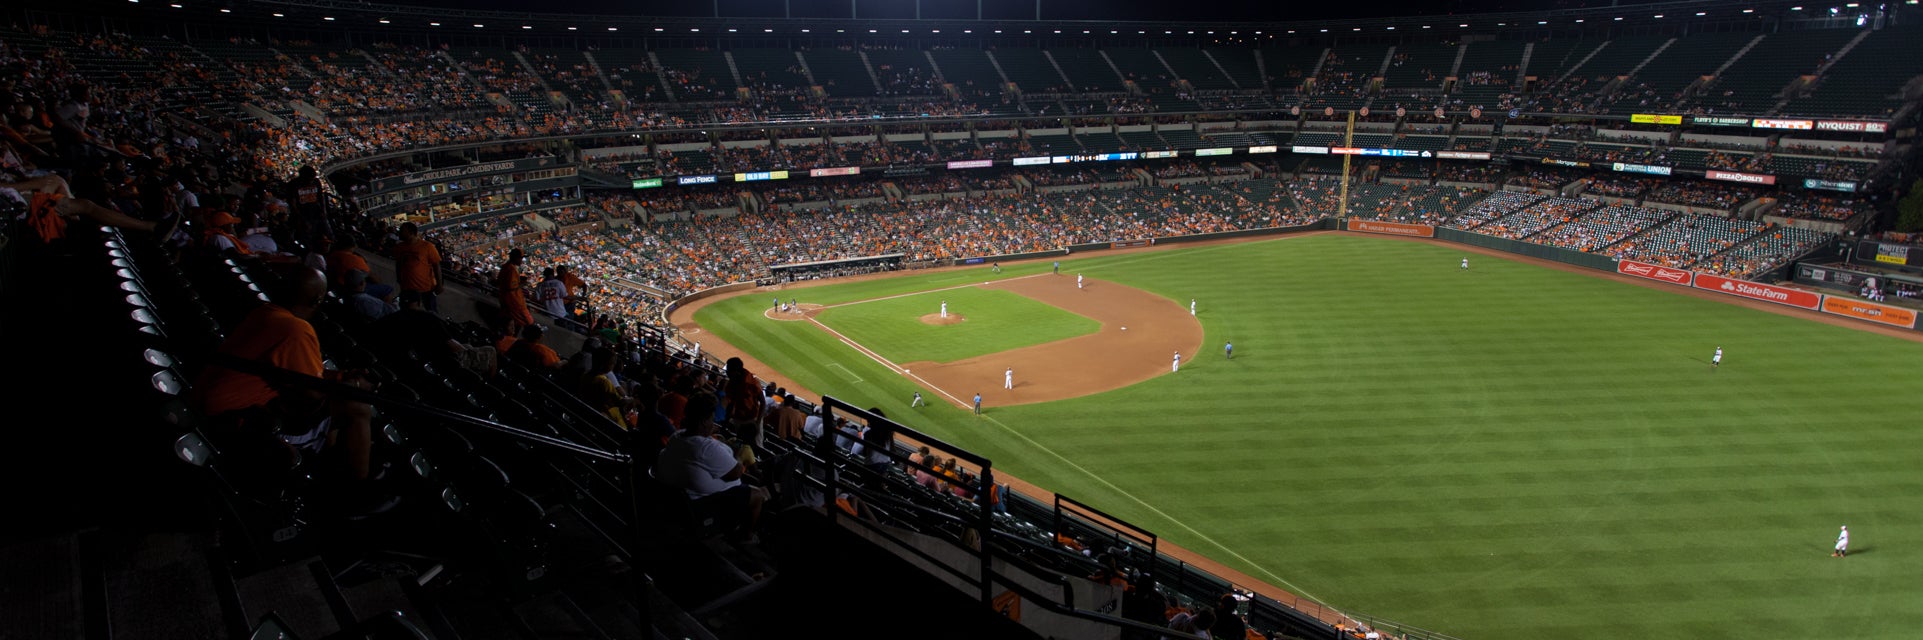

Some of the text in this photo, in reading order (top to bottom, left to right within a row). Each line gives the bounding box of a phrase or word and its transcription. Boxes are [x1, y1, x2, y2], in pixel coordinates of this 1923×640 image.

[445, 167, 461, 178] PARK
[494, 161, 515, 171] YARDS
[1647, 165, 1671, 175] UNION
[1716, 172, 1735, 180] PIZZA
